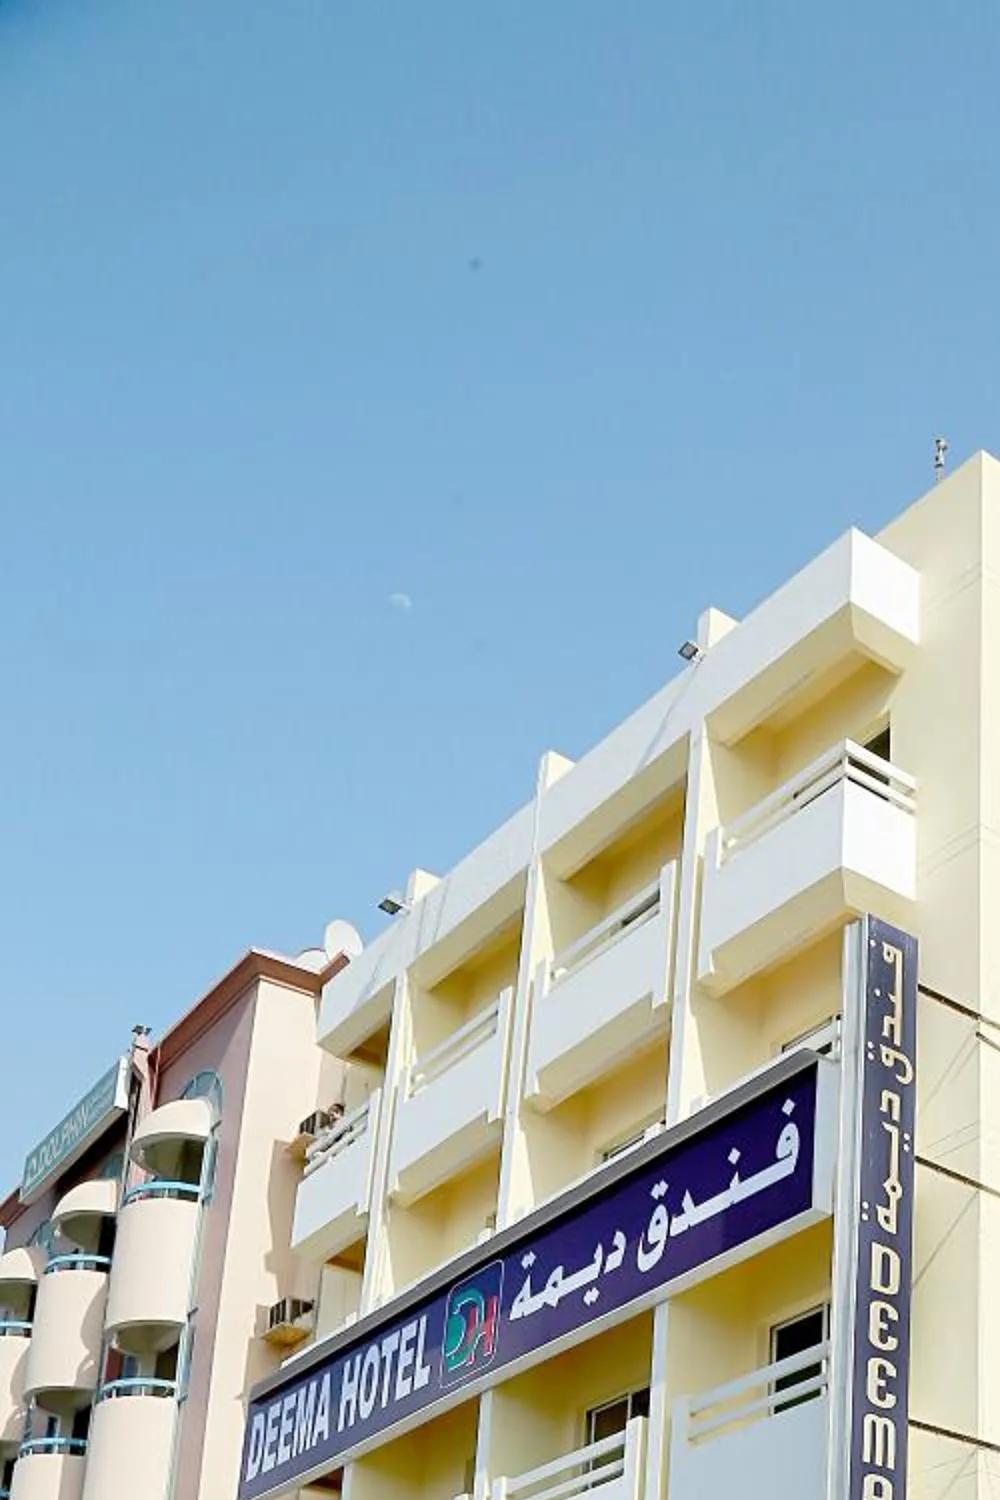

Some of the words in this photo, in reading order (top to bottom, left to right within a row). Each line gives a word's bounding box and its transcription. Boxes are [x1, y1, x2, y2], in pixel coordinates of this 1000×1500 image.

[637, 1098, 800, 1274] فندق
[508, 1229, 626, 1321] ديمة
[244, 1380, 332, 1483] DEEMA
[337, 1315, 431, 1433] HOTEL
